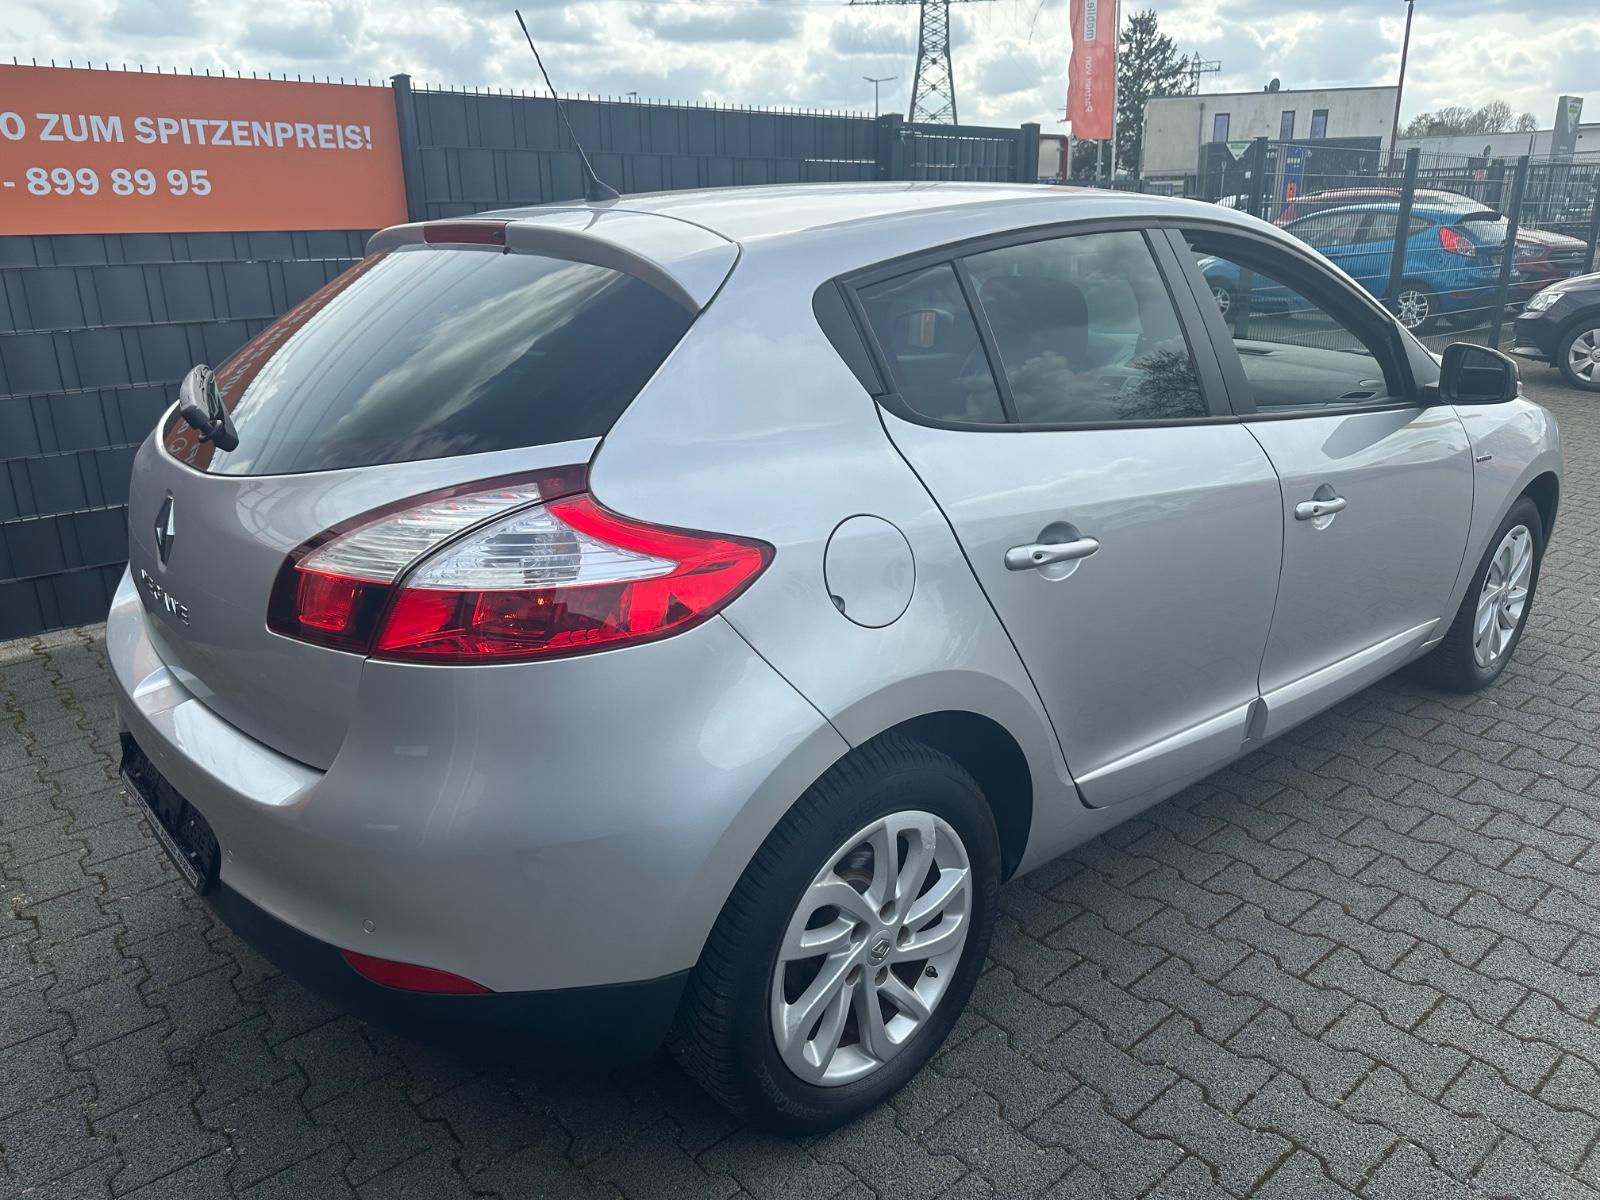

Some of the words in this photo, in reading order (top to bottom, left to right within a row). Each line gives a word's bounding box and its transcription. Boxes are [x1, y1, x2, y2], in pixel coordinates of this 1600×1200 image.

[36, 112, 125, 143] ZUM
[134, 116, 374, 151] SPITZENPREIS!
[25, 167, 100, 196] 899
[110, 168, 157, 196] 89
[166, 169, 212, 196] 95
